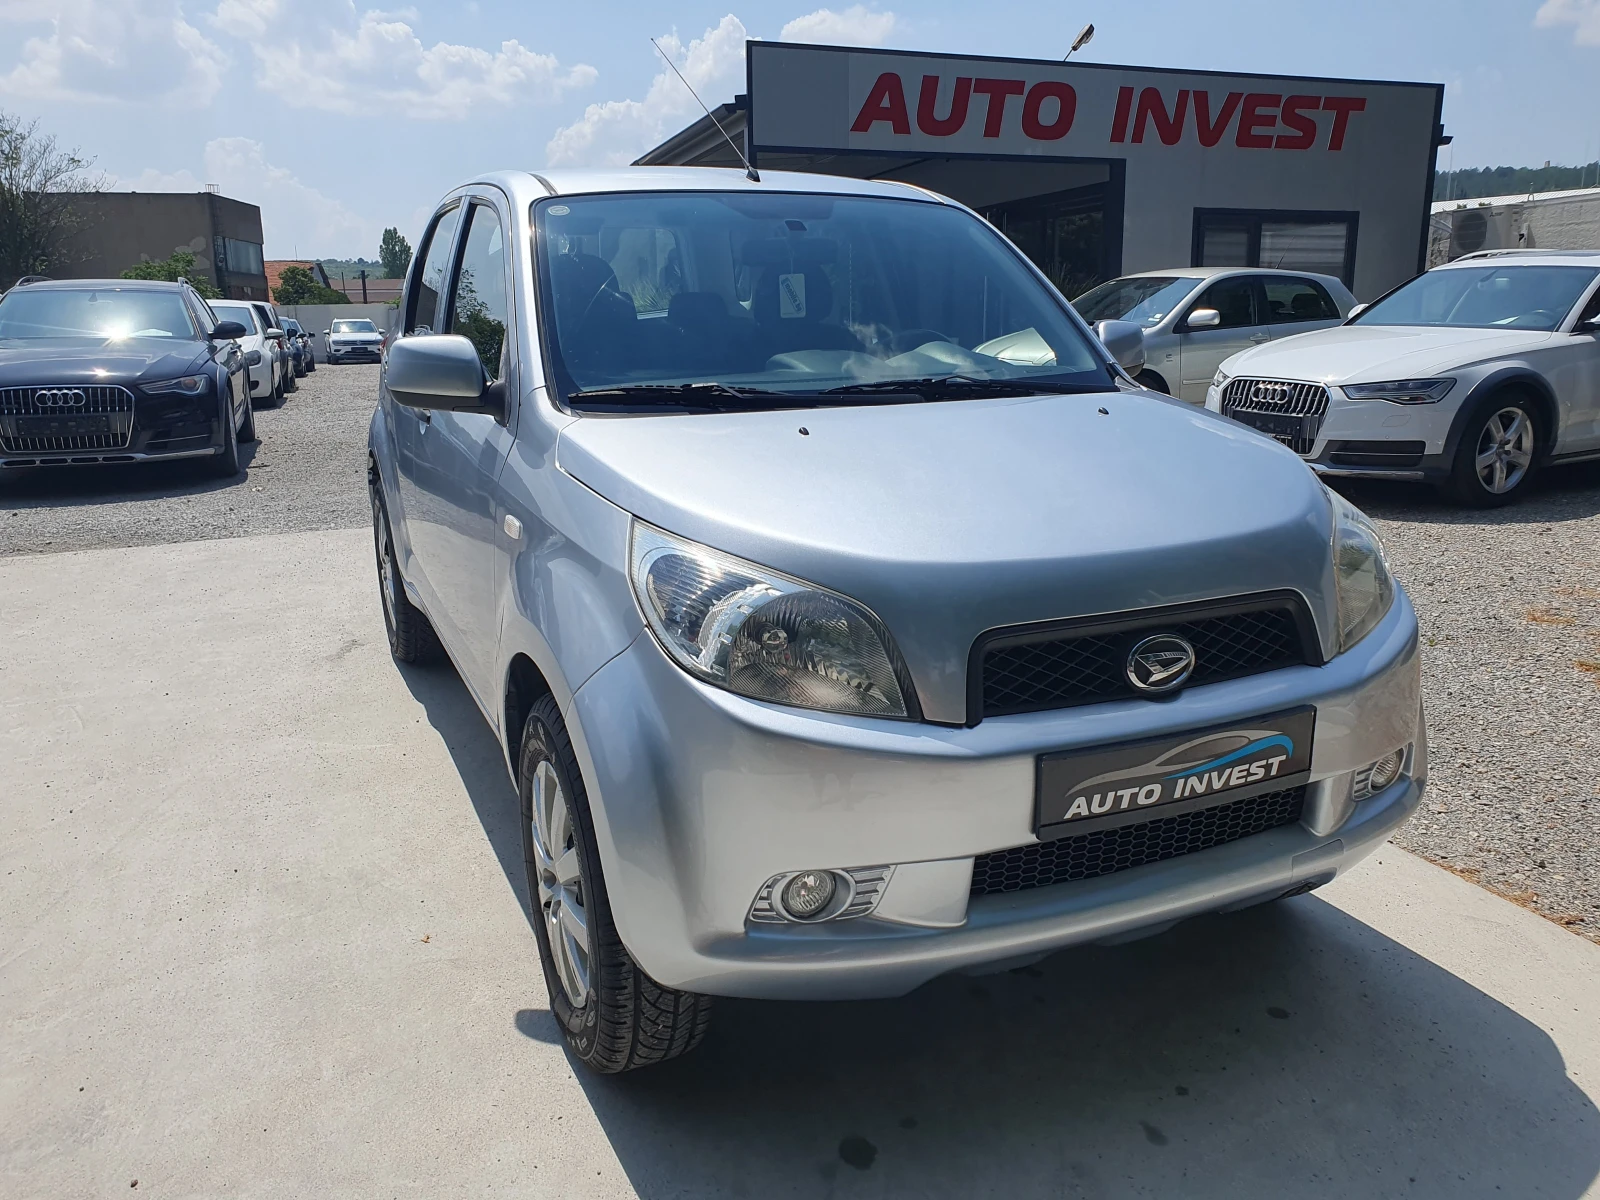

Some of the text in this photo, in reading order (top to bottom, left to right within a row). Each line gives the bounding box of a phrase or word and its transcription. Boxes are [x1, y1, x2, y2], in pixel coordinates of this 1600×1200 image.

[850, 72, 1367, 151] AUTO INVEST
[1063, 754, 1287, 819] AUTO INVEST
